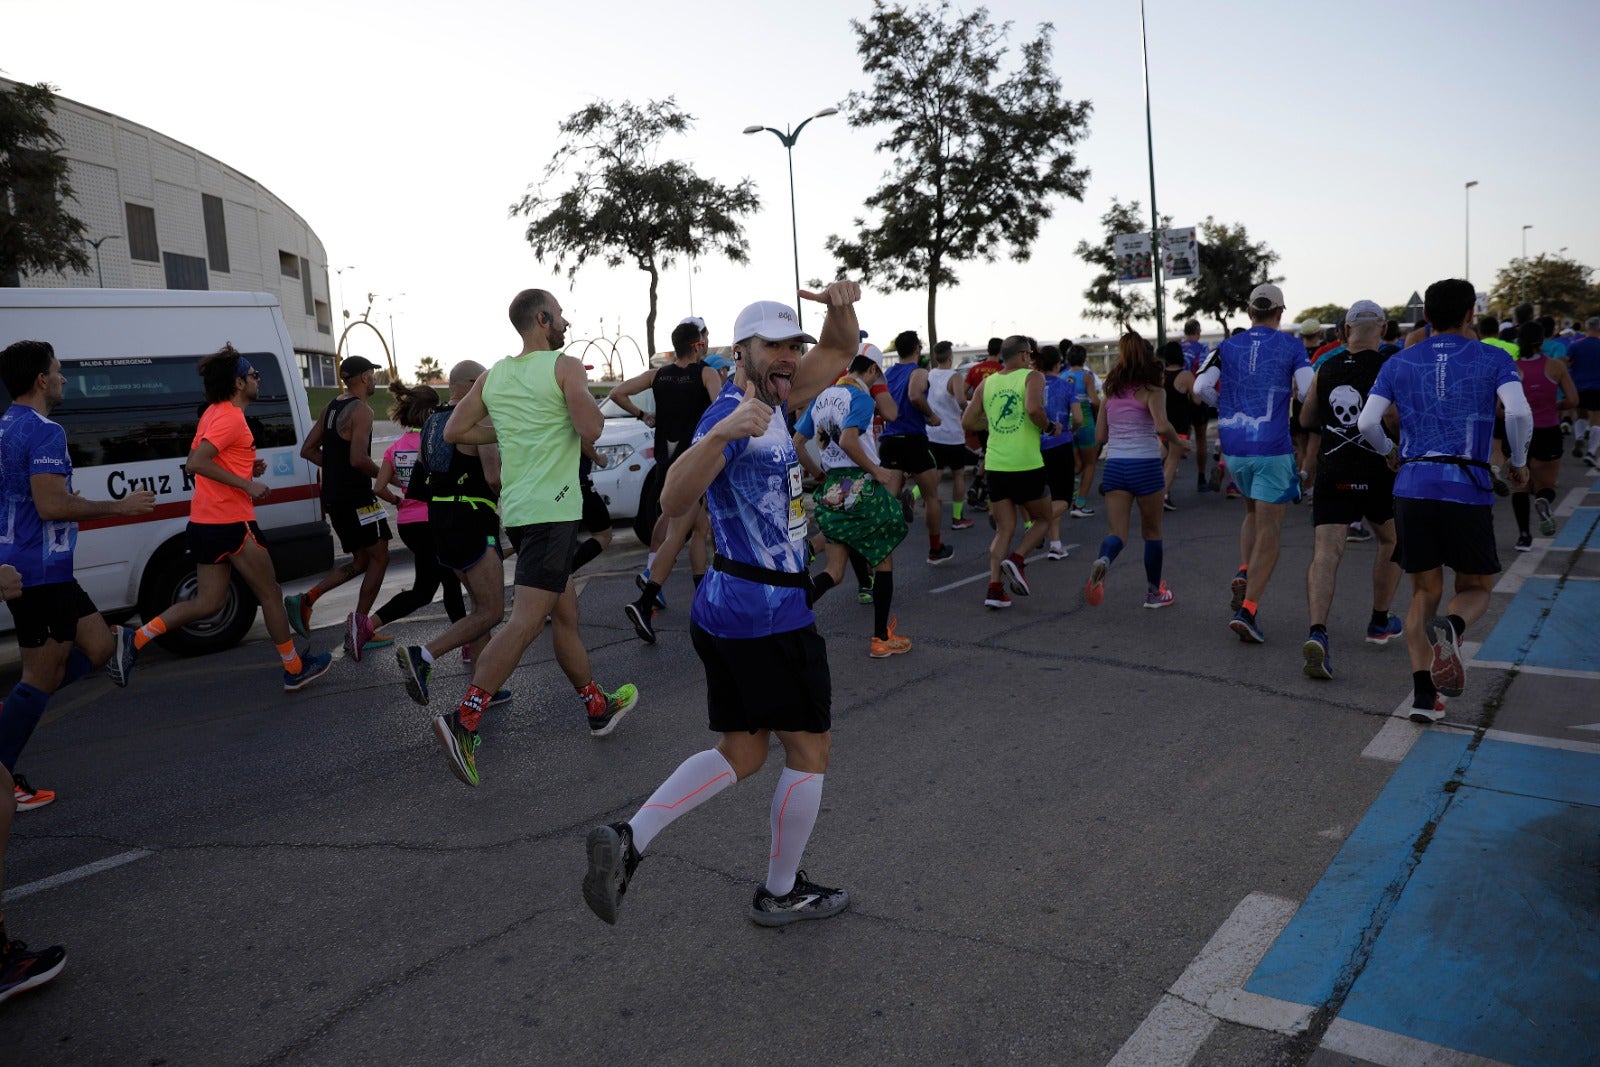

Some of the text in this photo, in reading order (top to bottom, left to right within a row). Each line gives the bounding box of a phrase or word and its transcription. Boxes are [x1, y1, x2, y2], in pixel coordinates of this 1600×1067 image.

[113, 358, 153, 366] EMERGENCIA
[1436, 353, 1448, 362] 31
[107, 471, 172, 500] Cruz
